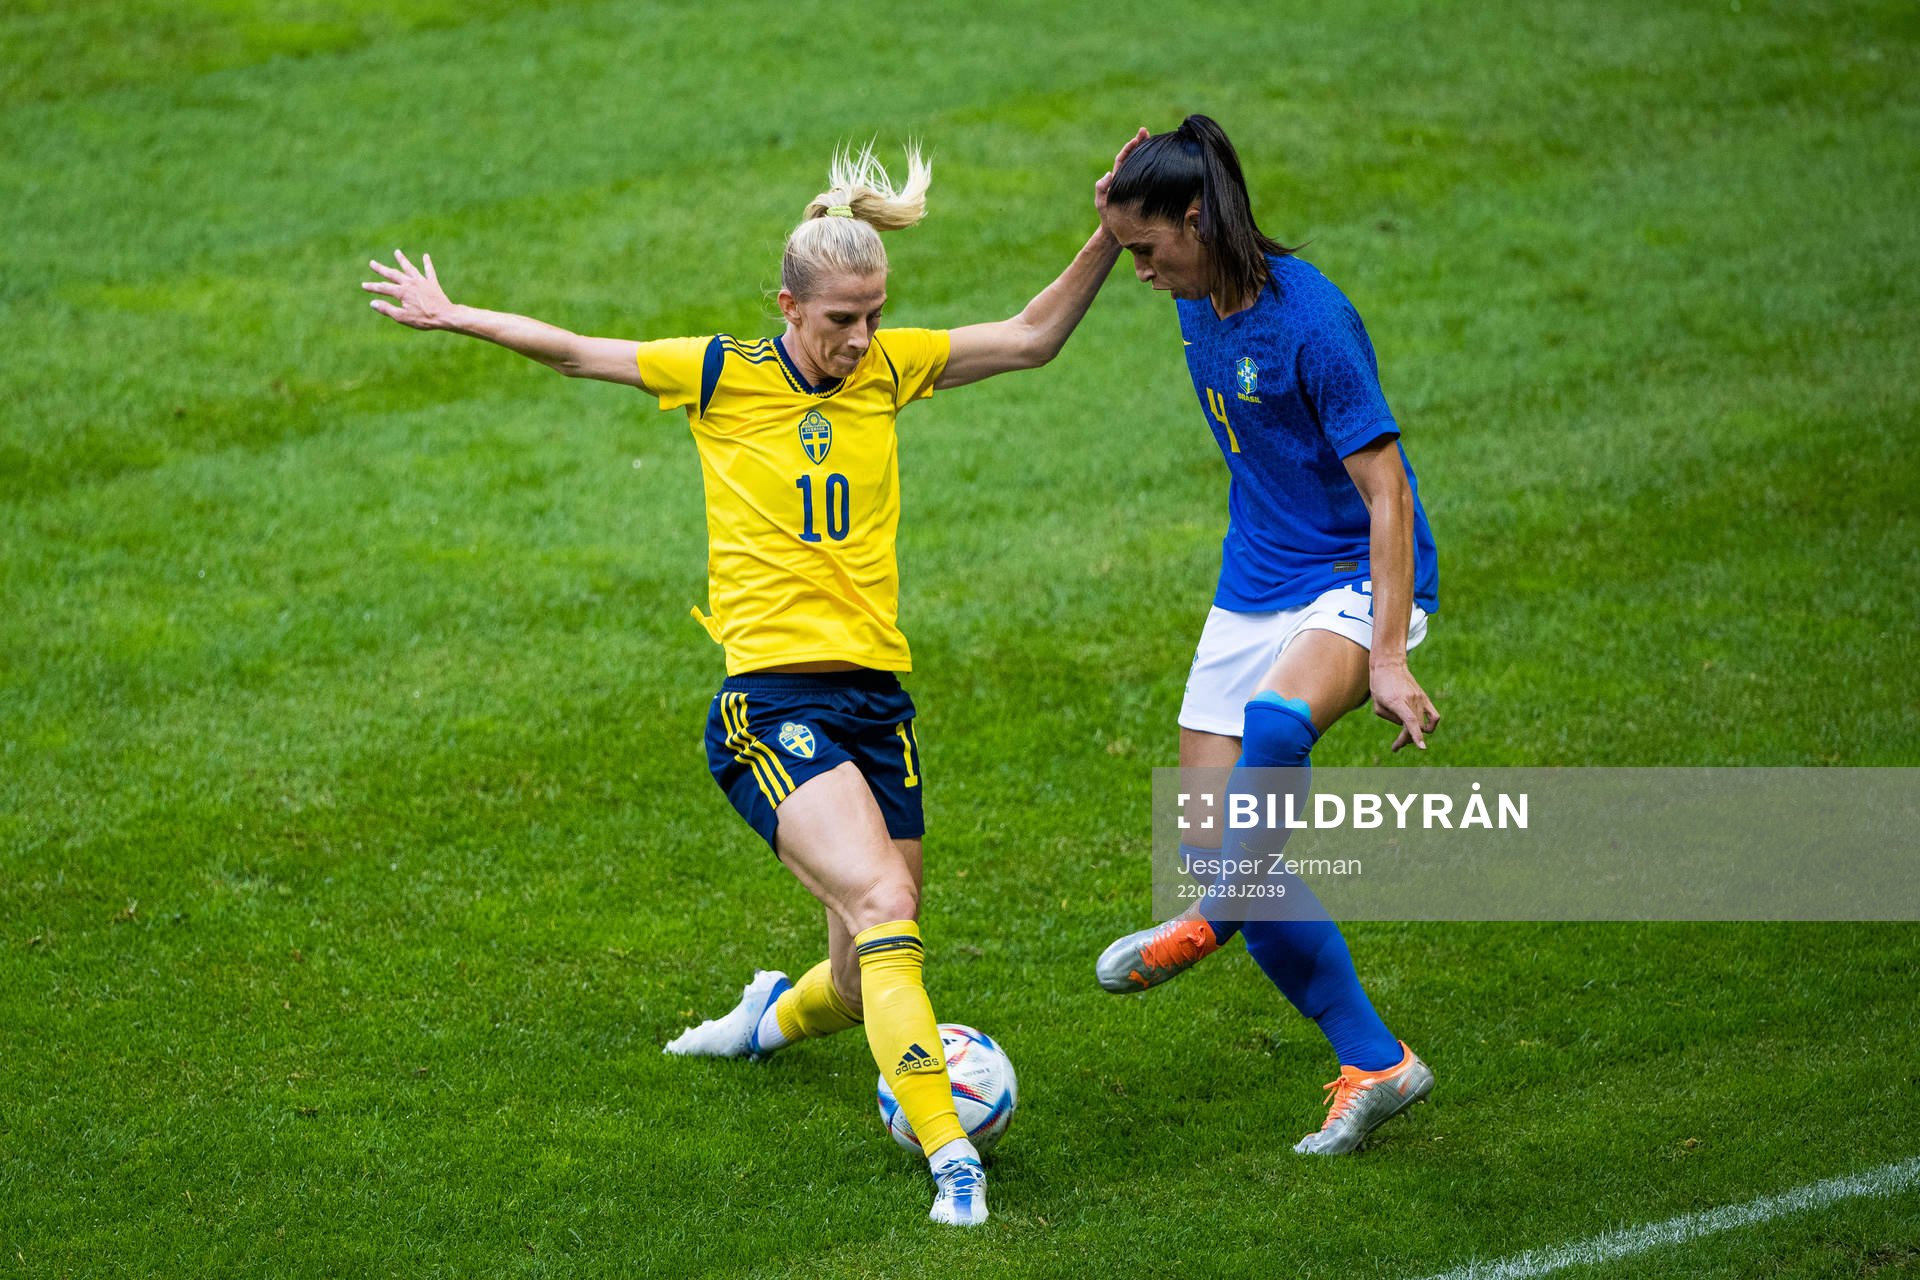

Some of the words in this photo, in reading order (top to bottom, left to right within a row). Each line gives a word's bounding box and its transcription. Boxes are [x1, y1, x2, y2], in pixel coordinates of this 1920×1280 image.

[1206, 387, 1241, 453] 4
[796, 473, 850, 542] 10
[896, 718, 919, 788] 1
[895, 1058, 939, 1076] adidas
